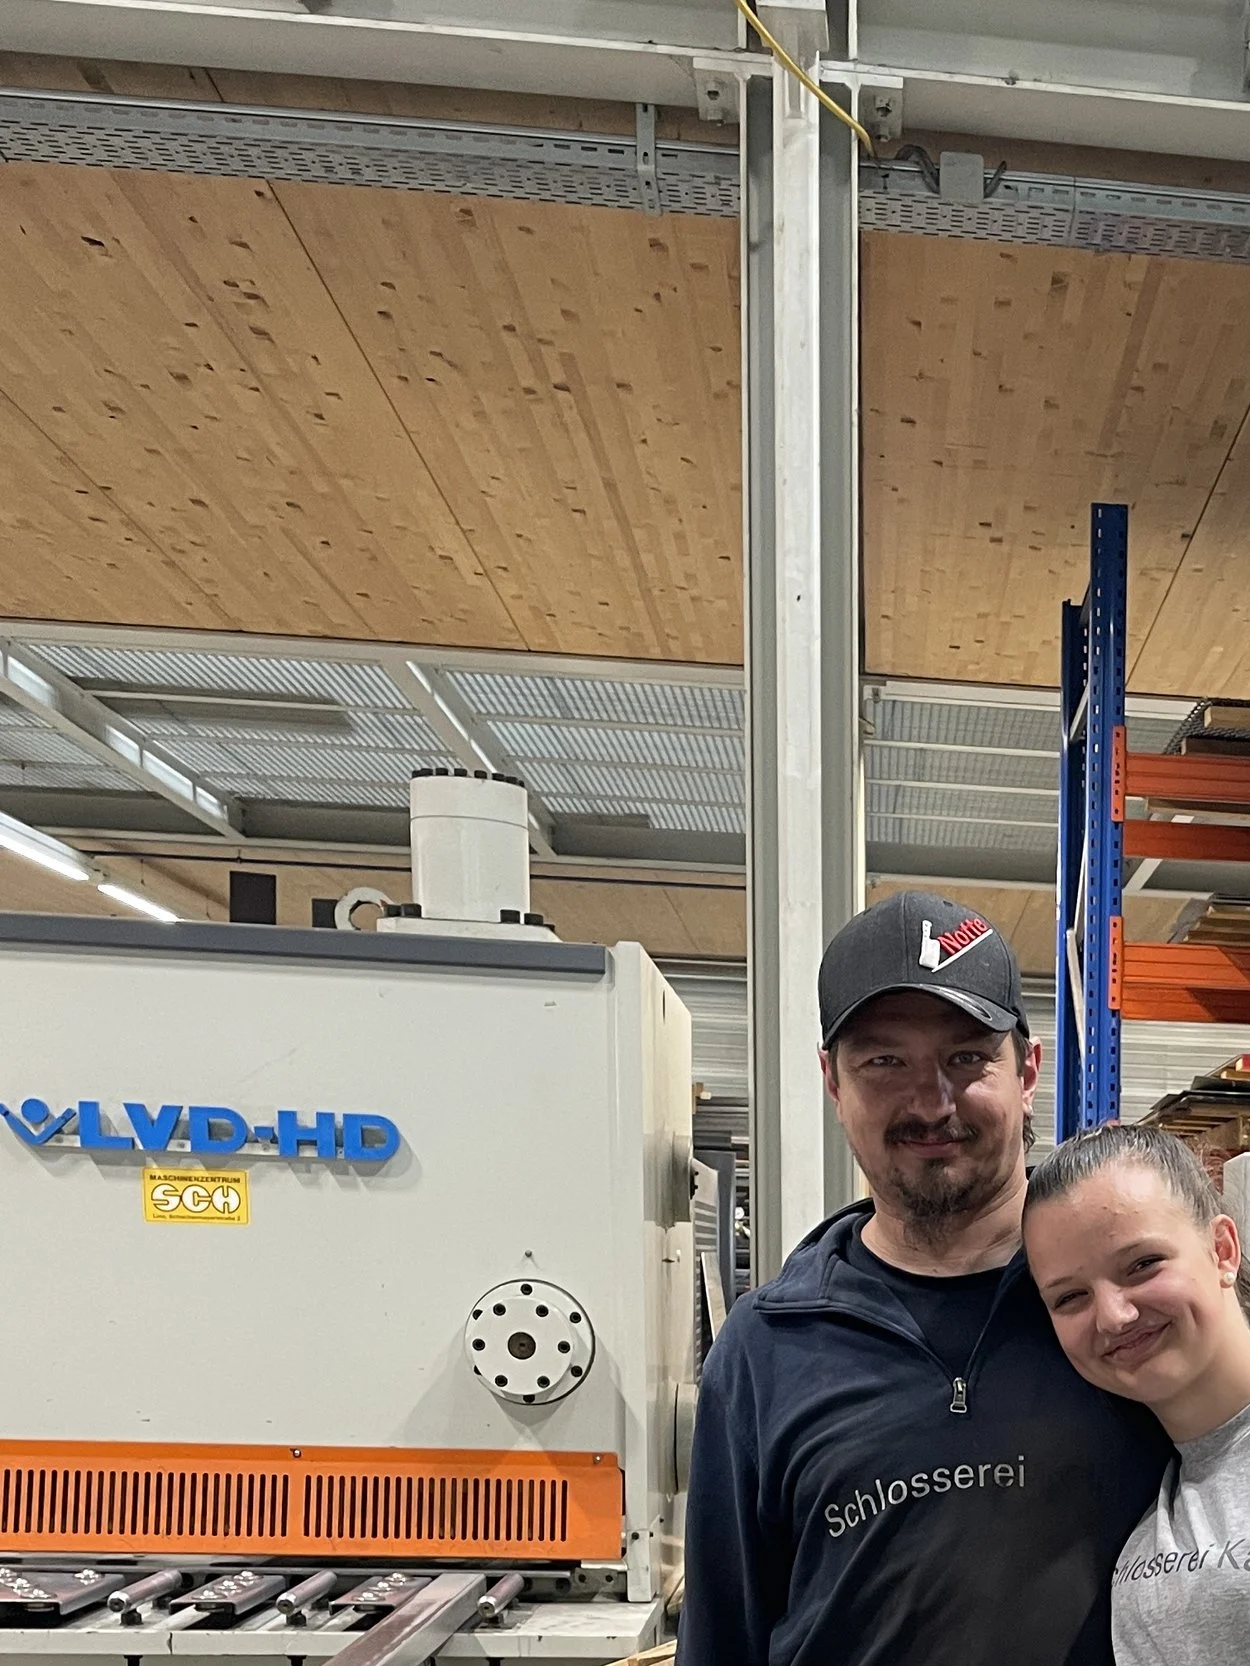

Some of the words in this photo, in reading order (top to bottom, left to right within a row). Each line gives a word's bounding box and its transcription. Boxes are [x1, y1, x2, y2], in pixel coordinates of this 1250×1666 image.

[937, 918, 988, 956] Notte
[78, 1101, 400, 1161] LVD-HD
[149, 1174, 241, 1184] MASCHINENZENTRUM
[151, 1183, 241, 1214] SCH
[824, 1455, 1025, 1538] Schlosserei
[1111, 1543, 1215, 1587] hlosserei
